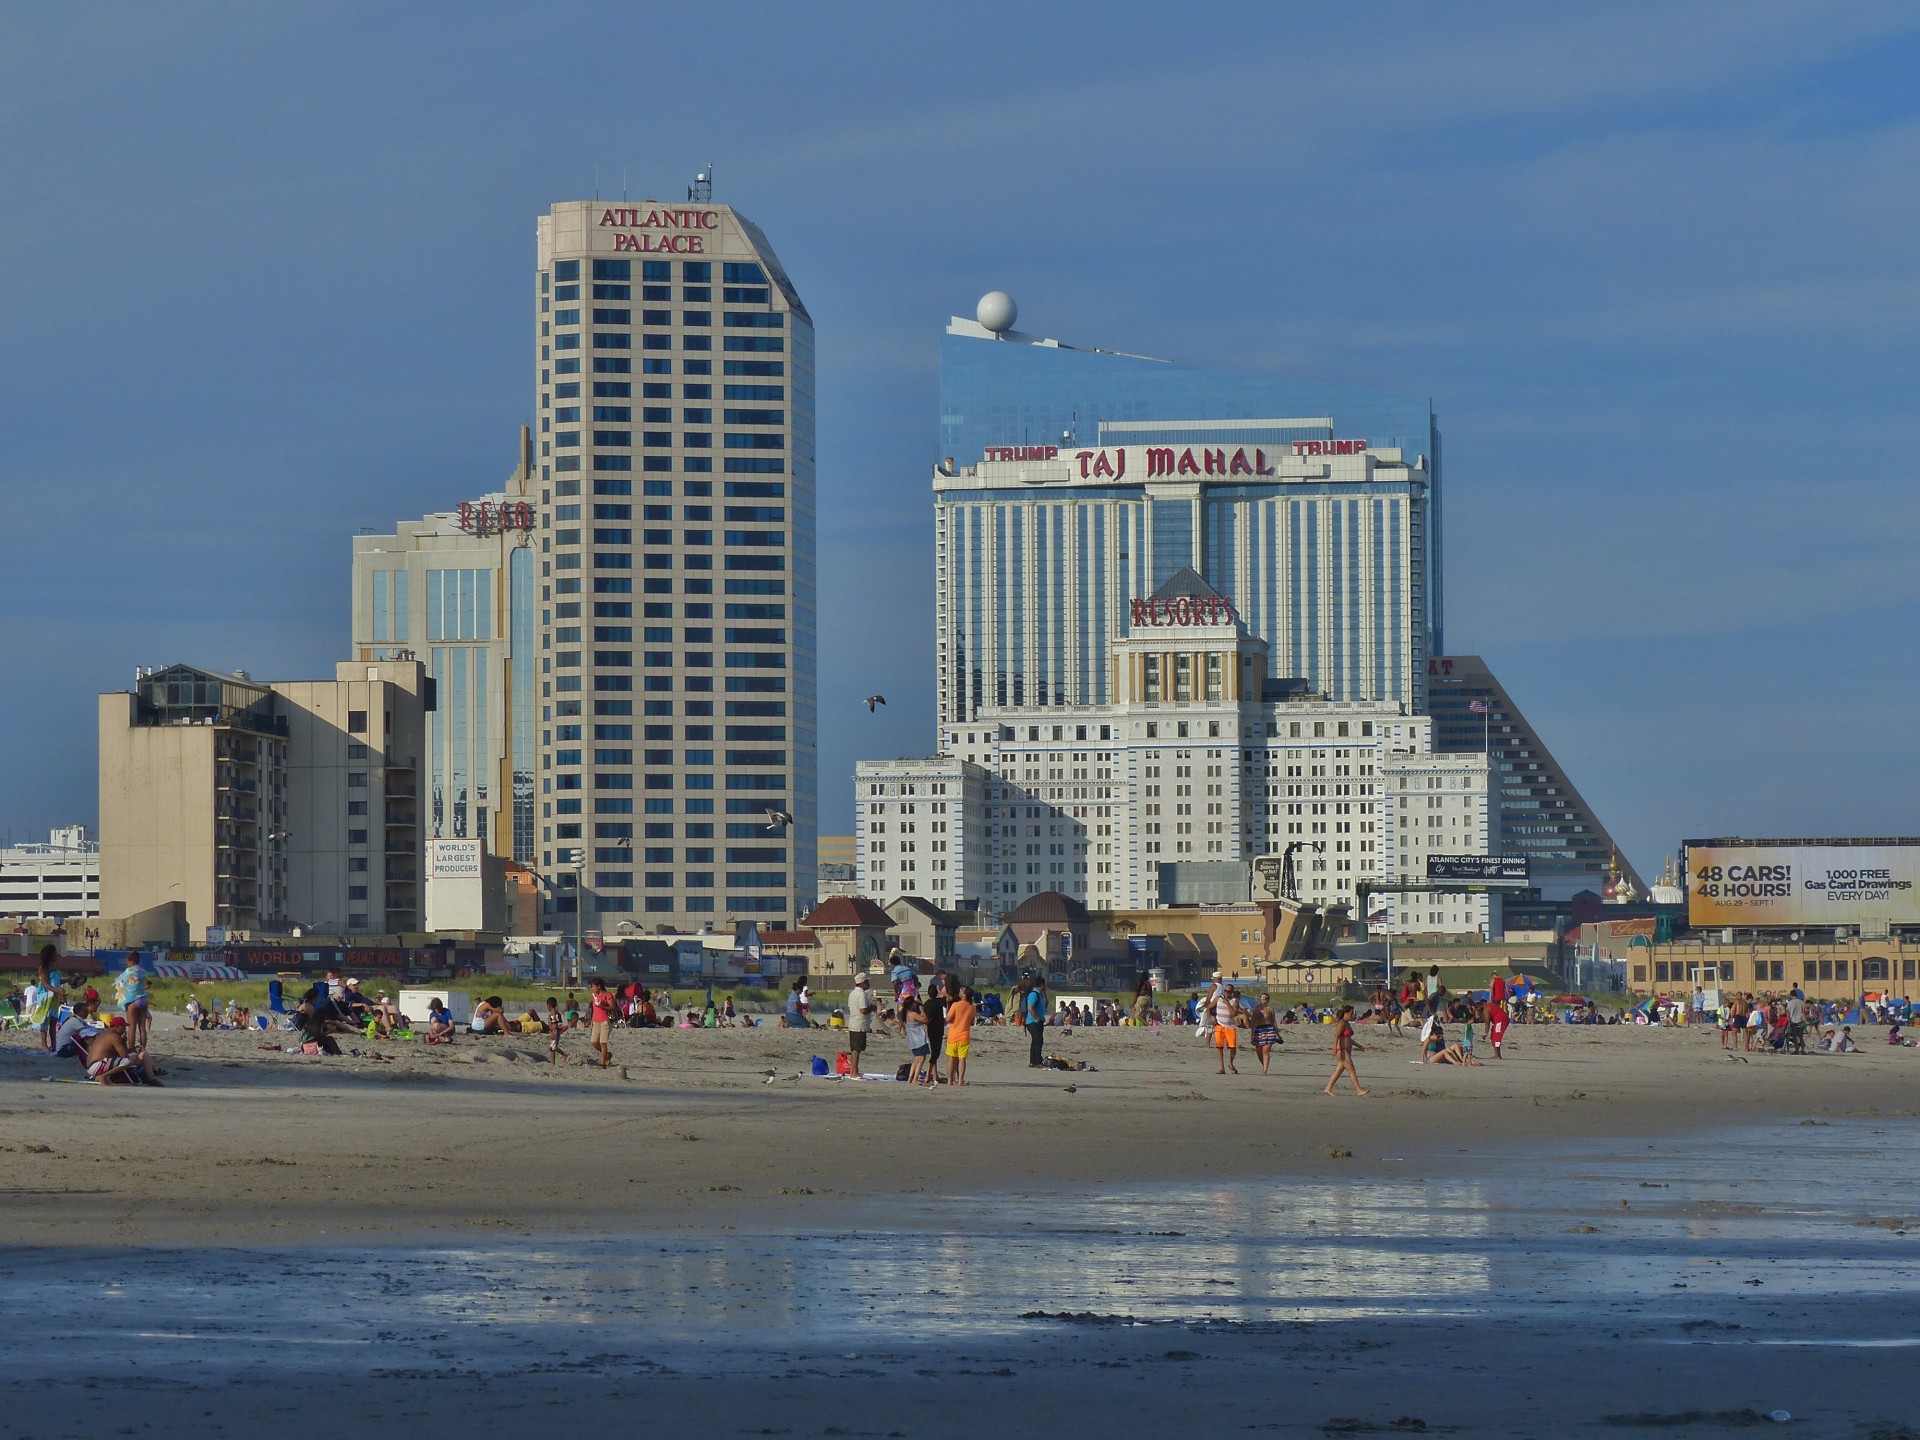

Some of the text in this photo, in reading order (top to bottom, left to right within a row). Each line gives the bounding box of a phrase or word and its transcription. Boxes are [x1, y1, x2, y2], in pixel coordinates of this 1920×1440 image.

[599, 208, 719, 230] ATLANTIC
[613, 233, 704, 254] PALACE
[984, 445, 1058, 461] TRUMP
[1292, 440, 1367, 455] TRUMP
[1075, 447, 1275, 482] TAJ MAHAL
[460, 500, 530, 530] RESO
[1133, 596, 1234, 627] RESORTS
[1696, 865, 1791, 881] 48 CARS!
[1826, 869, 1890, 880] 1,000 FREE
[1697, 883, 1791, 897] 48 HOURS!
[1804, 878, 1912, 891] Gas Card Drawings
[1827, 891, 1889, 901] EVERY DAY!
[248, 951, 302, 965] WORLD
[346, 951, 375, 965] PEANUT
[377, 951, 404, 965] WORLD
